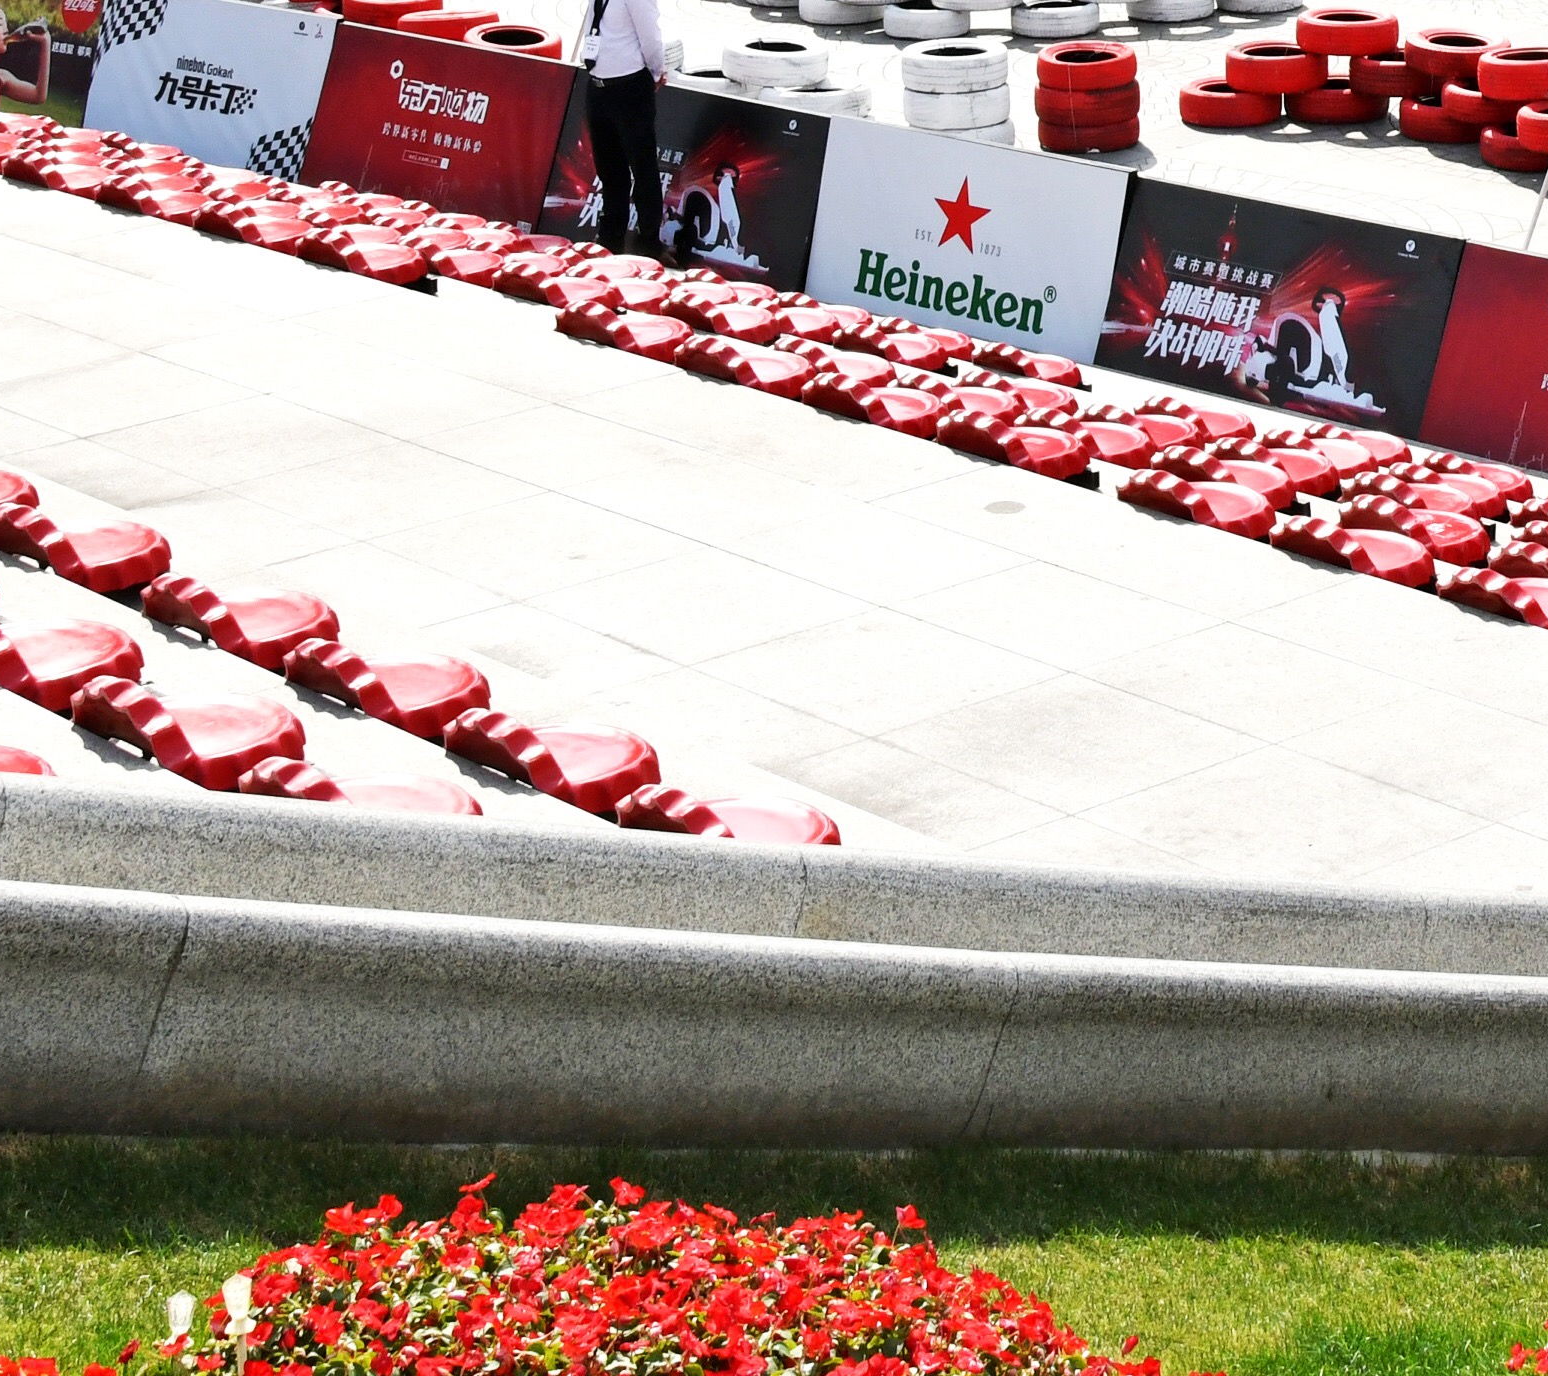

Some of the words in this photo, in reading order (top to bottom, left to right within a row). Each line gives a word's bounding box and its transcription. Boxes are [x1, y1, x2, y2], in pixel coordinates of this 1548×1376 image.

[176, 57, 206, 75] ninebot
[207, 63, 234, 80] Gokart
[155, 70, 240, 115] 九号卡丁
[915, 227, 934, 245] EST.
[979, 242, 1002, 258] 1873
[853, 248, 1044, 335] Heineken
[1174, 253, 1277, 290] 城市赛道挑战赛
[1162, 280, 1260, 332] 潮酷随我
[1144, 318, 1246, 376] 决战明珠
